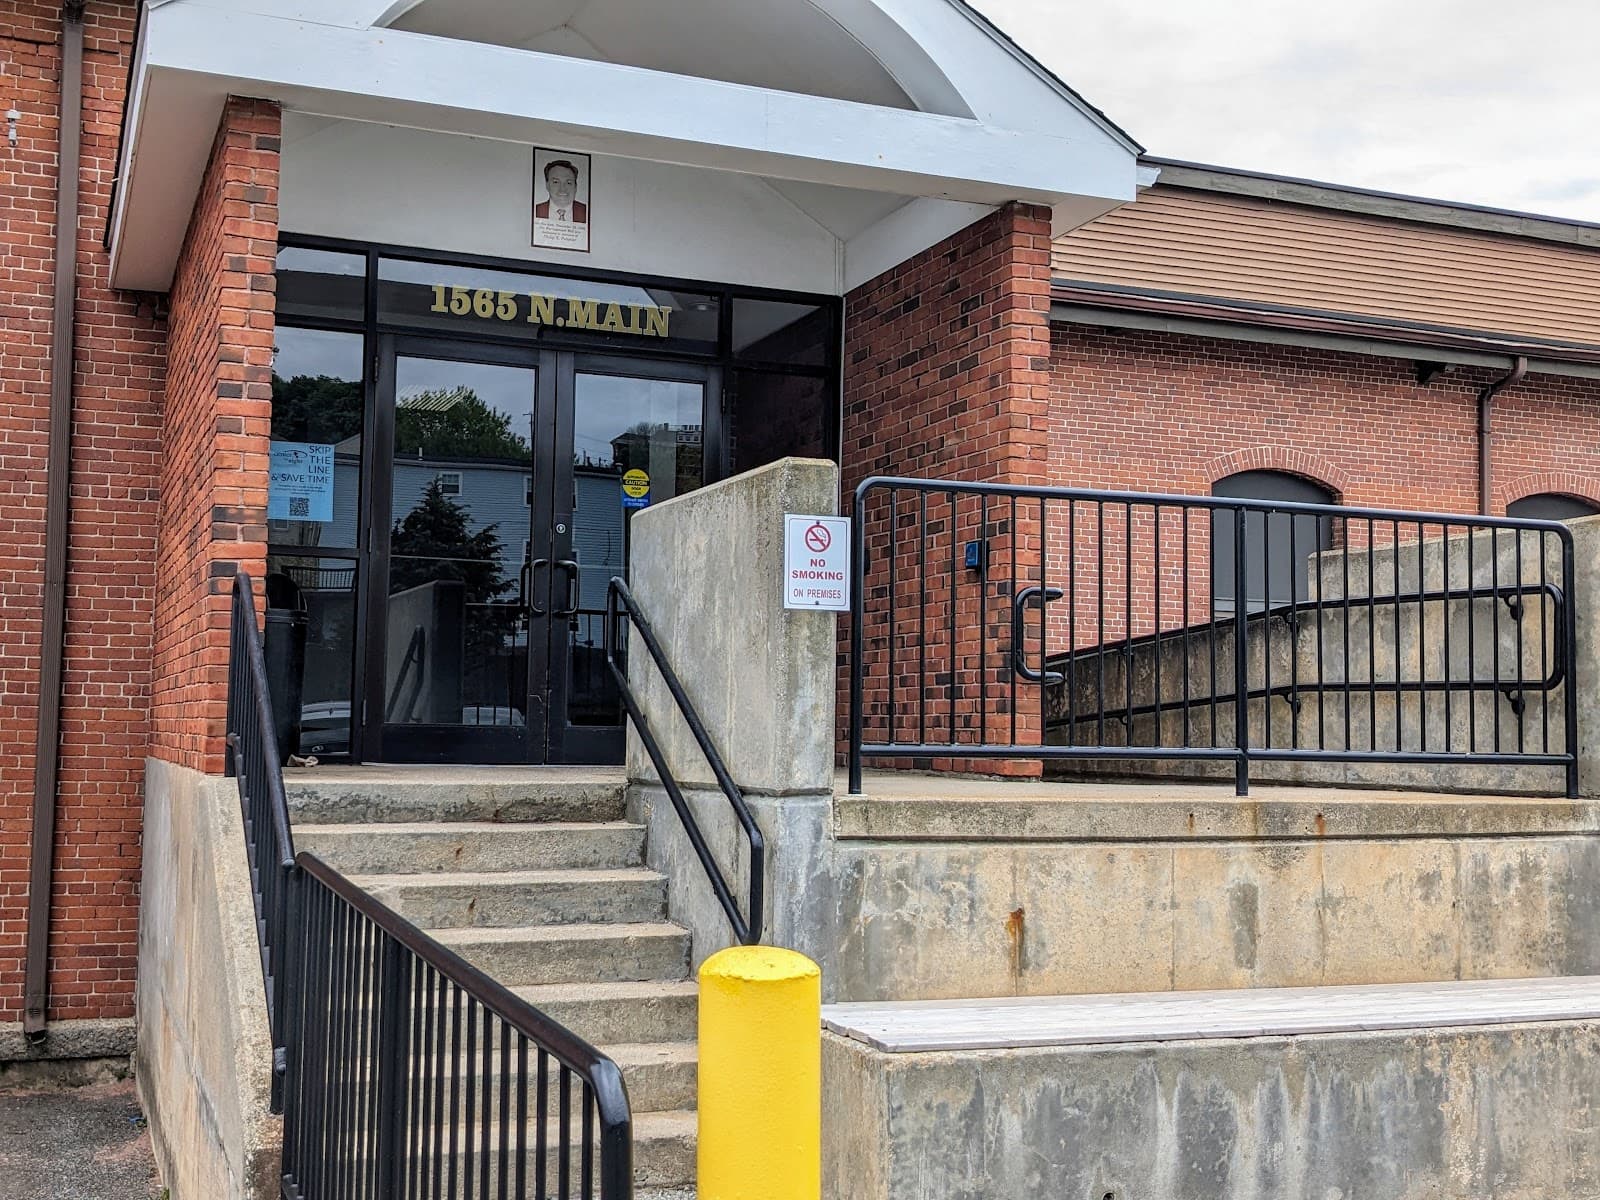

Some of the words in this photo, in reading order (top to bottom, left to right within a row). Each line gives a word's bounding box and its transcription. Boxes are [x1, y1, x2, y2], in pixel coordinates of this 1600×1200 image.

[431, 283, 518, 321] 1565
[527, 293, 672, 337] N.MAIN
[309, 445, 331, 454] SKIP
[309, 455, 331, 464] THE
[308, 464, 331, 474] LINE
[271, 473, 278, 481] &
[280, 473, 305, 483] SAVE
[308, 475, 330, 484] TIME
[810, 558, 826, 567] NO
[792, 570, 844, 580] SMOKING
[793, 588, 804, 598] ON
[807, 588, 842, 599] PREMISES
